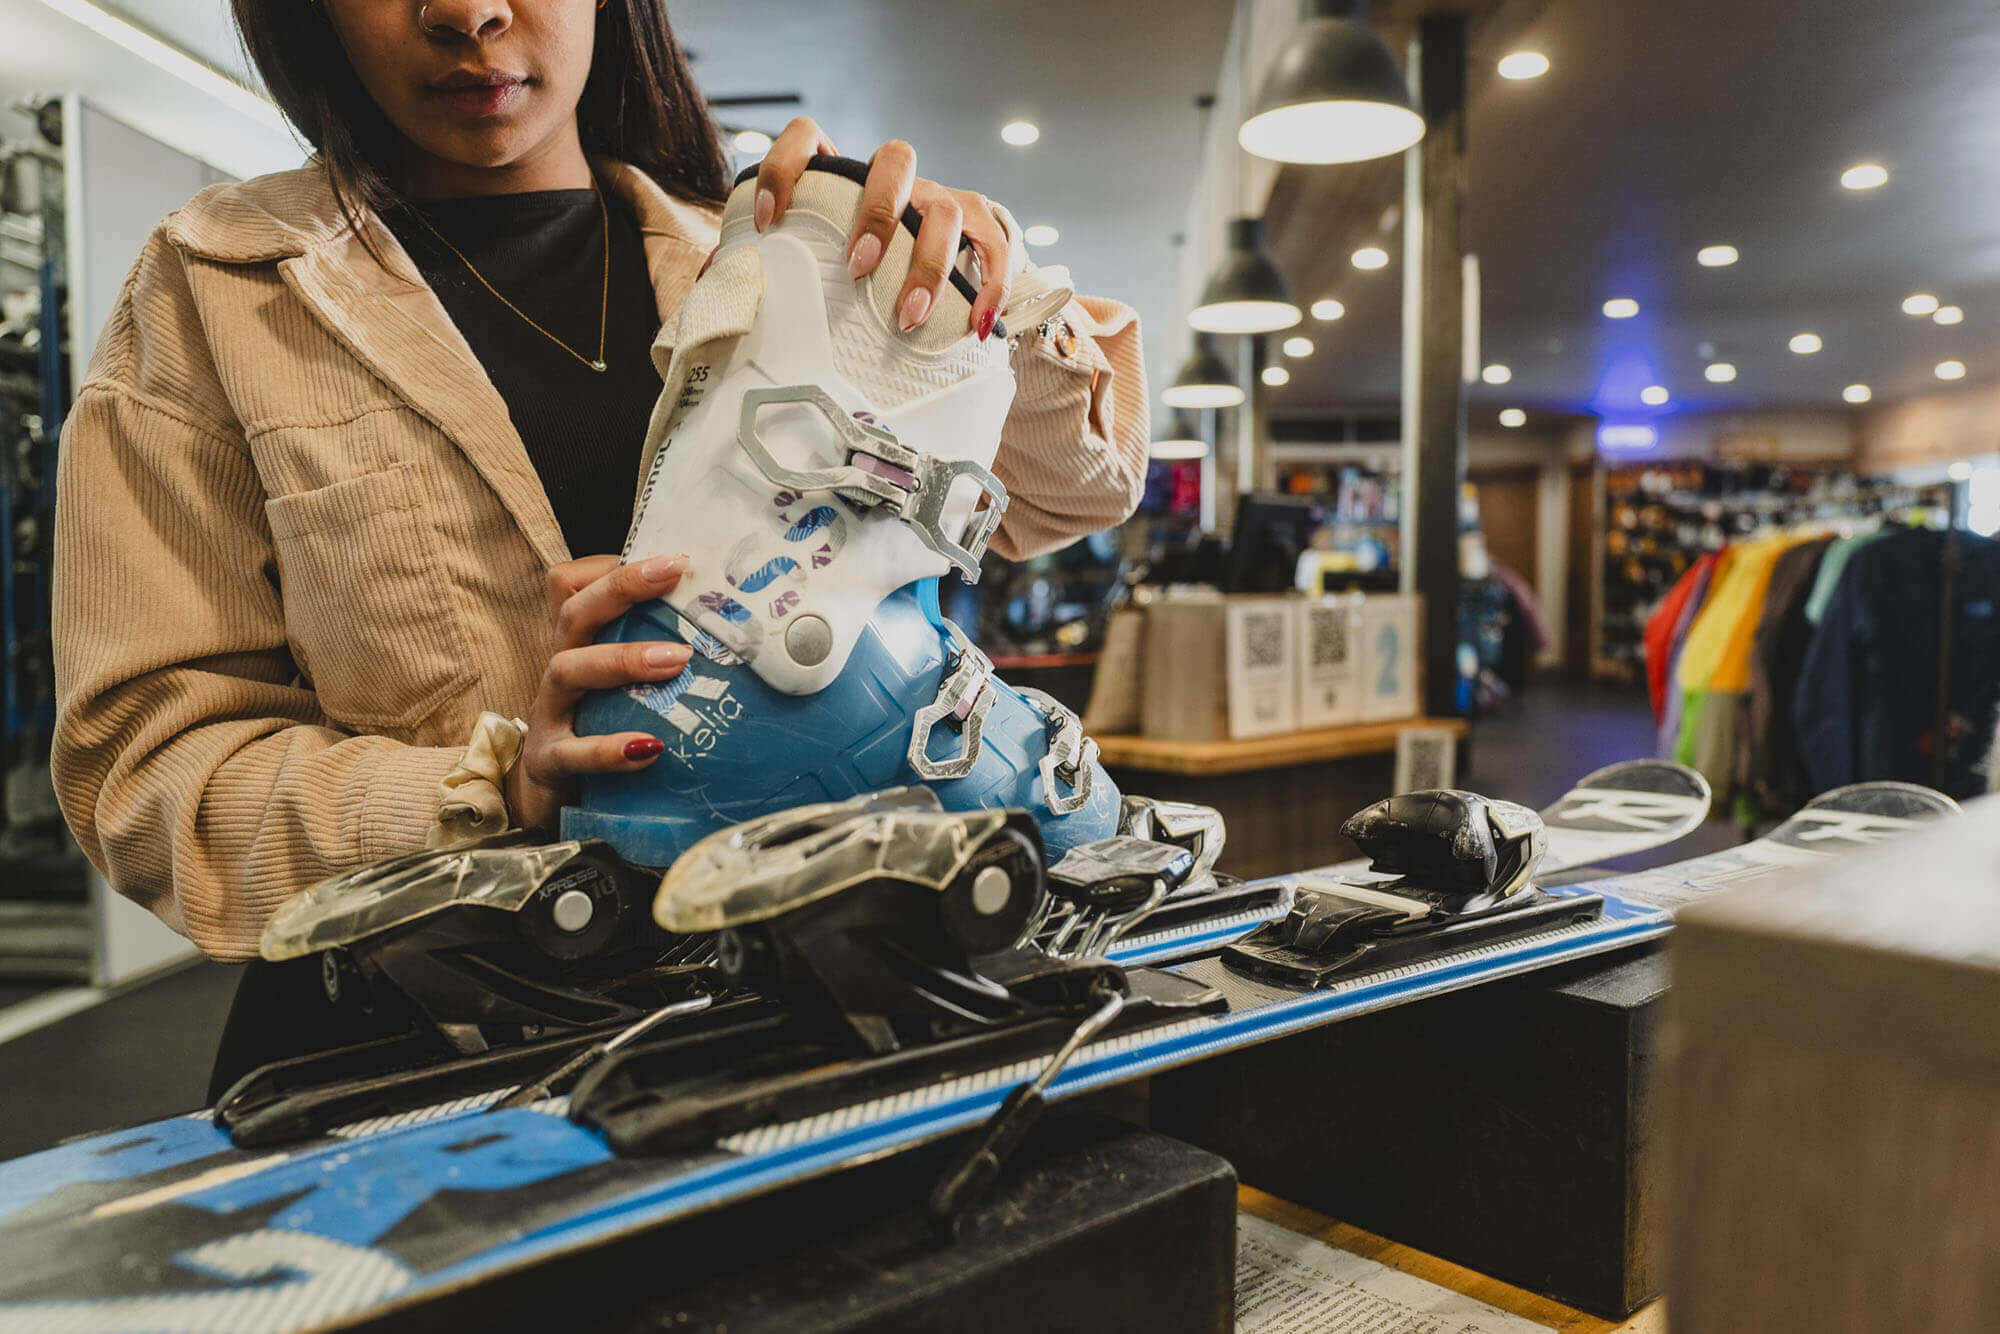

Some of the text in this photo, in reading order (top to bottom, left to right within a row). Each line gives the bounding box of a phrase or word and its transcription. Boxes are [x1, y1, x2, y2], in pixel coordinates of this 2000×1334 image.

[687, 366, 711, 383] 255
[1376, 620, 1399, 695] 2
[538, 866, 599, 901] XPRESS
